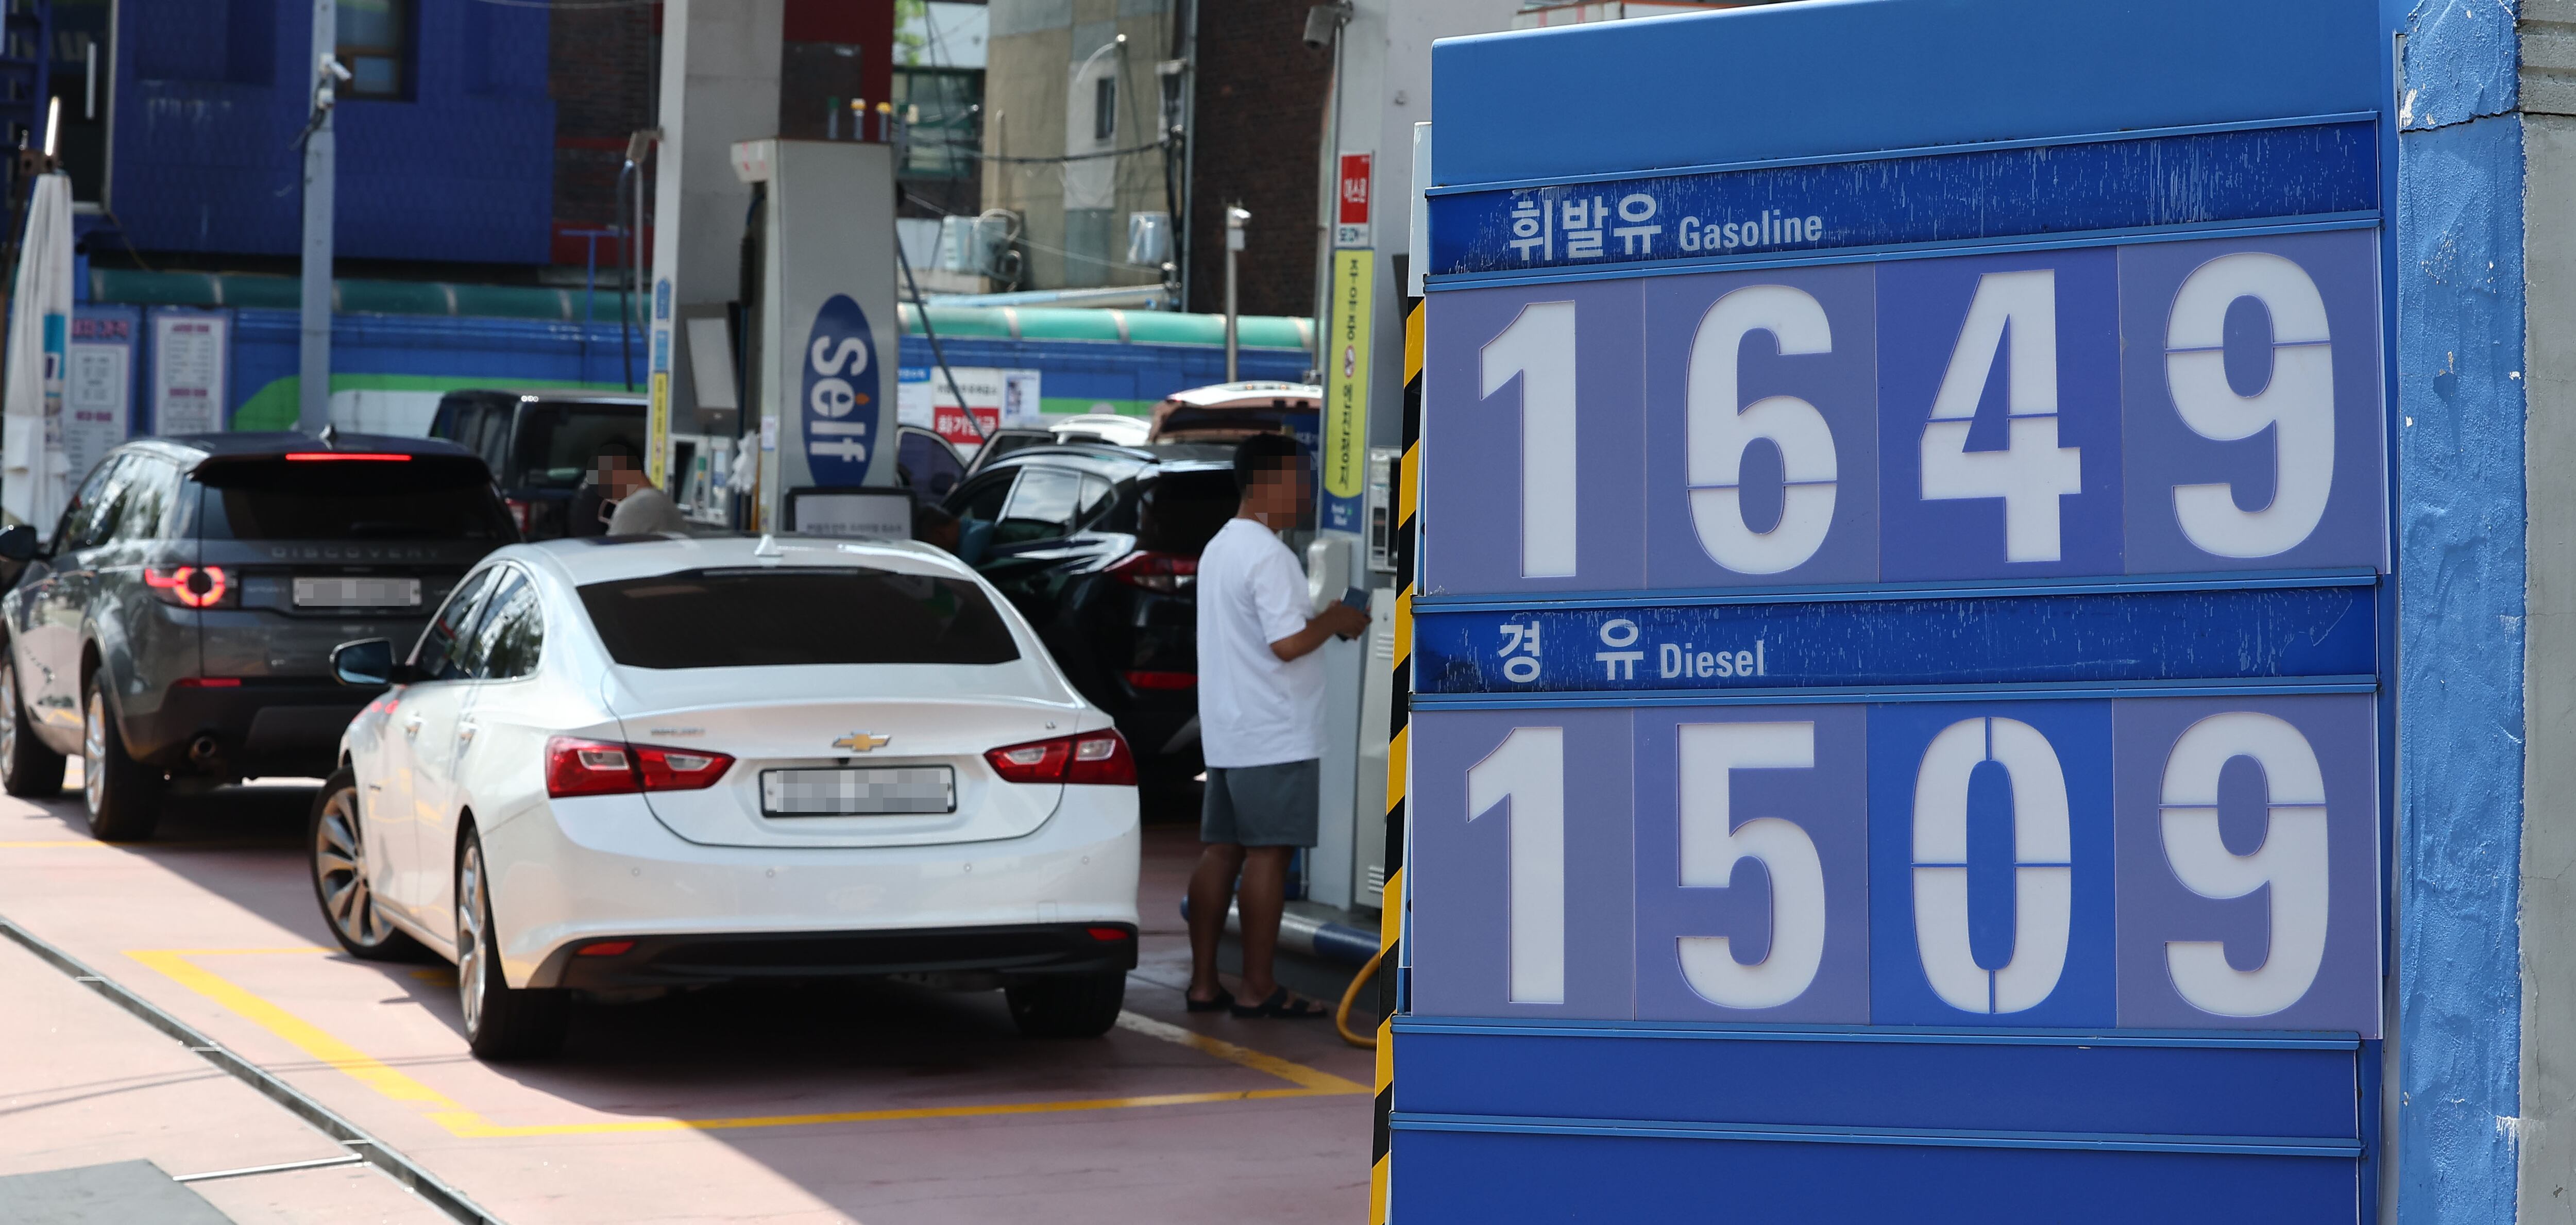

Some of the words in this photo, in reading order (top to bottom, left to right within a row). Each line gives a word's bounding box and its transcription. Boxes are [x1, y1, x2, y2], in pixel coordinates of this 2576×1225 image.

[1510, 193, 1662, 261] 휘발유
[1679, 210, 1823, 252] Gasoline
[810, 335, 869, 462] Self
[1479, 251, 2335, 578] 1649
[271, 547, 438, 559] DISCOVERY
[1660, 640, 1765, 679] Diesel
[1467, 711, 2329, 1017] 1509
